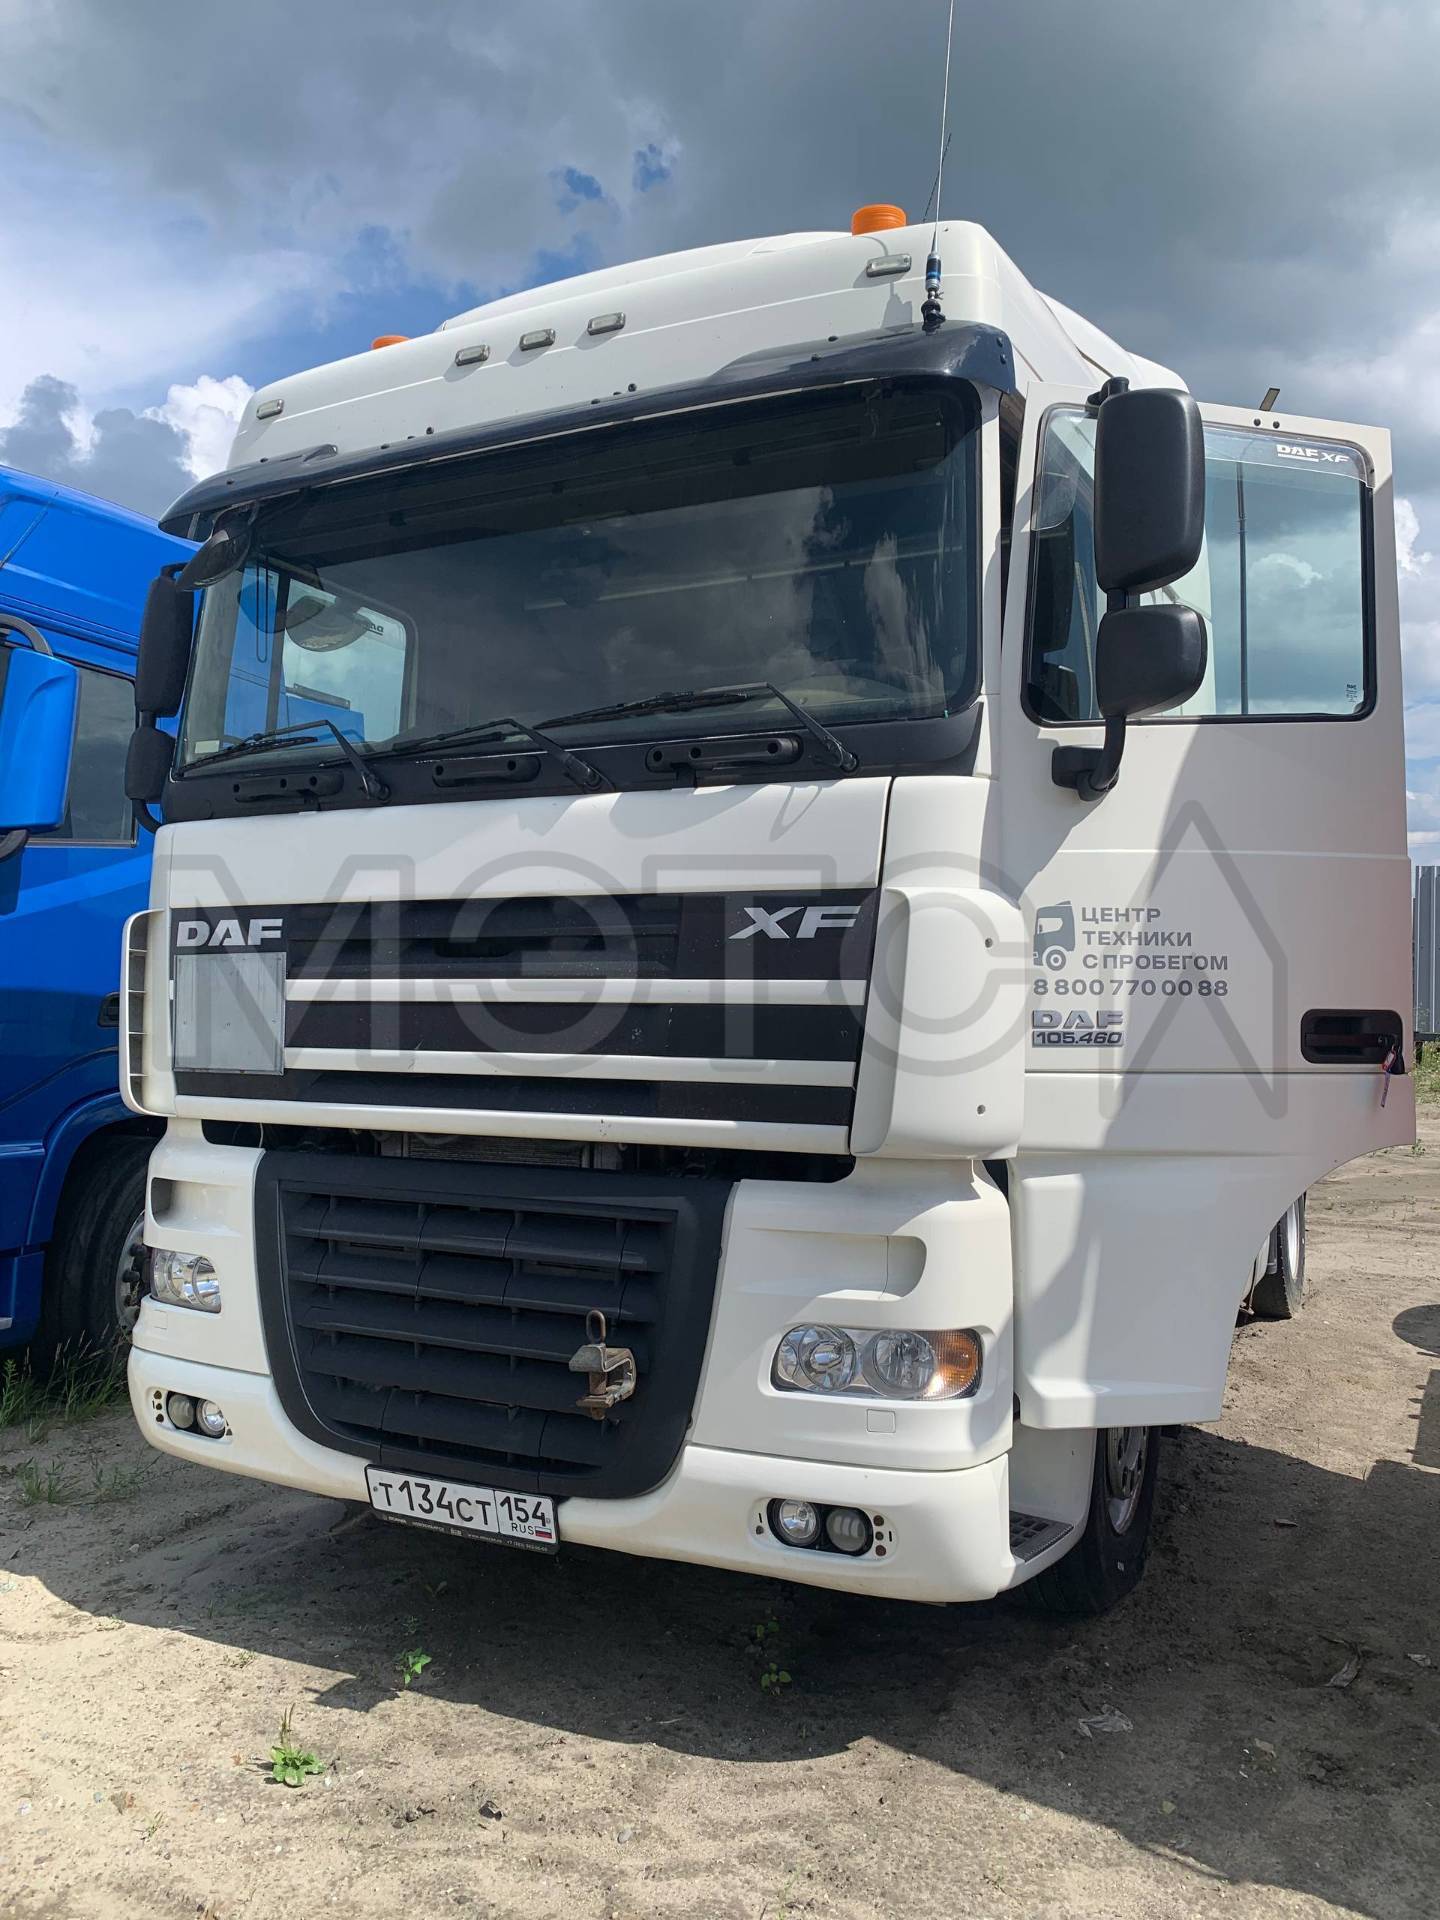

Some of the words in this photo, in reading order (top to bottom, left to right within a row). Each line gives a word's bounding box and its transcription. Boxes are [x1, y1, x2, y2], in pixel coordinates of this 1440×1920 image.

[1276, 444, 1319, 458] DAF
[1320, 452, 1350, 463] XF
[728, 905, 861, 940] XF
[1081, 907, 1161, 924] ЦЕНТР
[177, 918, 283, 947] DAF
[1082, 930, 1193, 947] ТЕХНИКИ
[1082, 953, 1099, 970] С
[1102, 954, 1229, 971] ПРОБЕГОМ
[1033, 979, 1049, 996] 8
[1054, 979, 1105, 996] 800
[1109, 979, 1157, 996] 770
[1161, 979, 1193, 997] 00
[1198, 979, 1229, 997] 88
[1032, 1009, 1124, 1030] DAF
[1035, 1030, 1123, 1046] 105.460
[499, 1495, 546, 1528] 154
[511, 1522, 535, 1536] RUS
